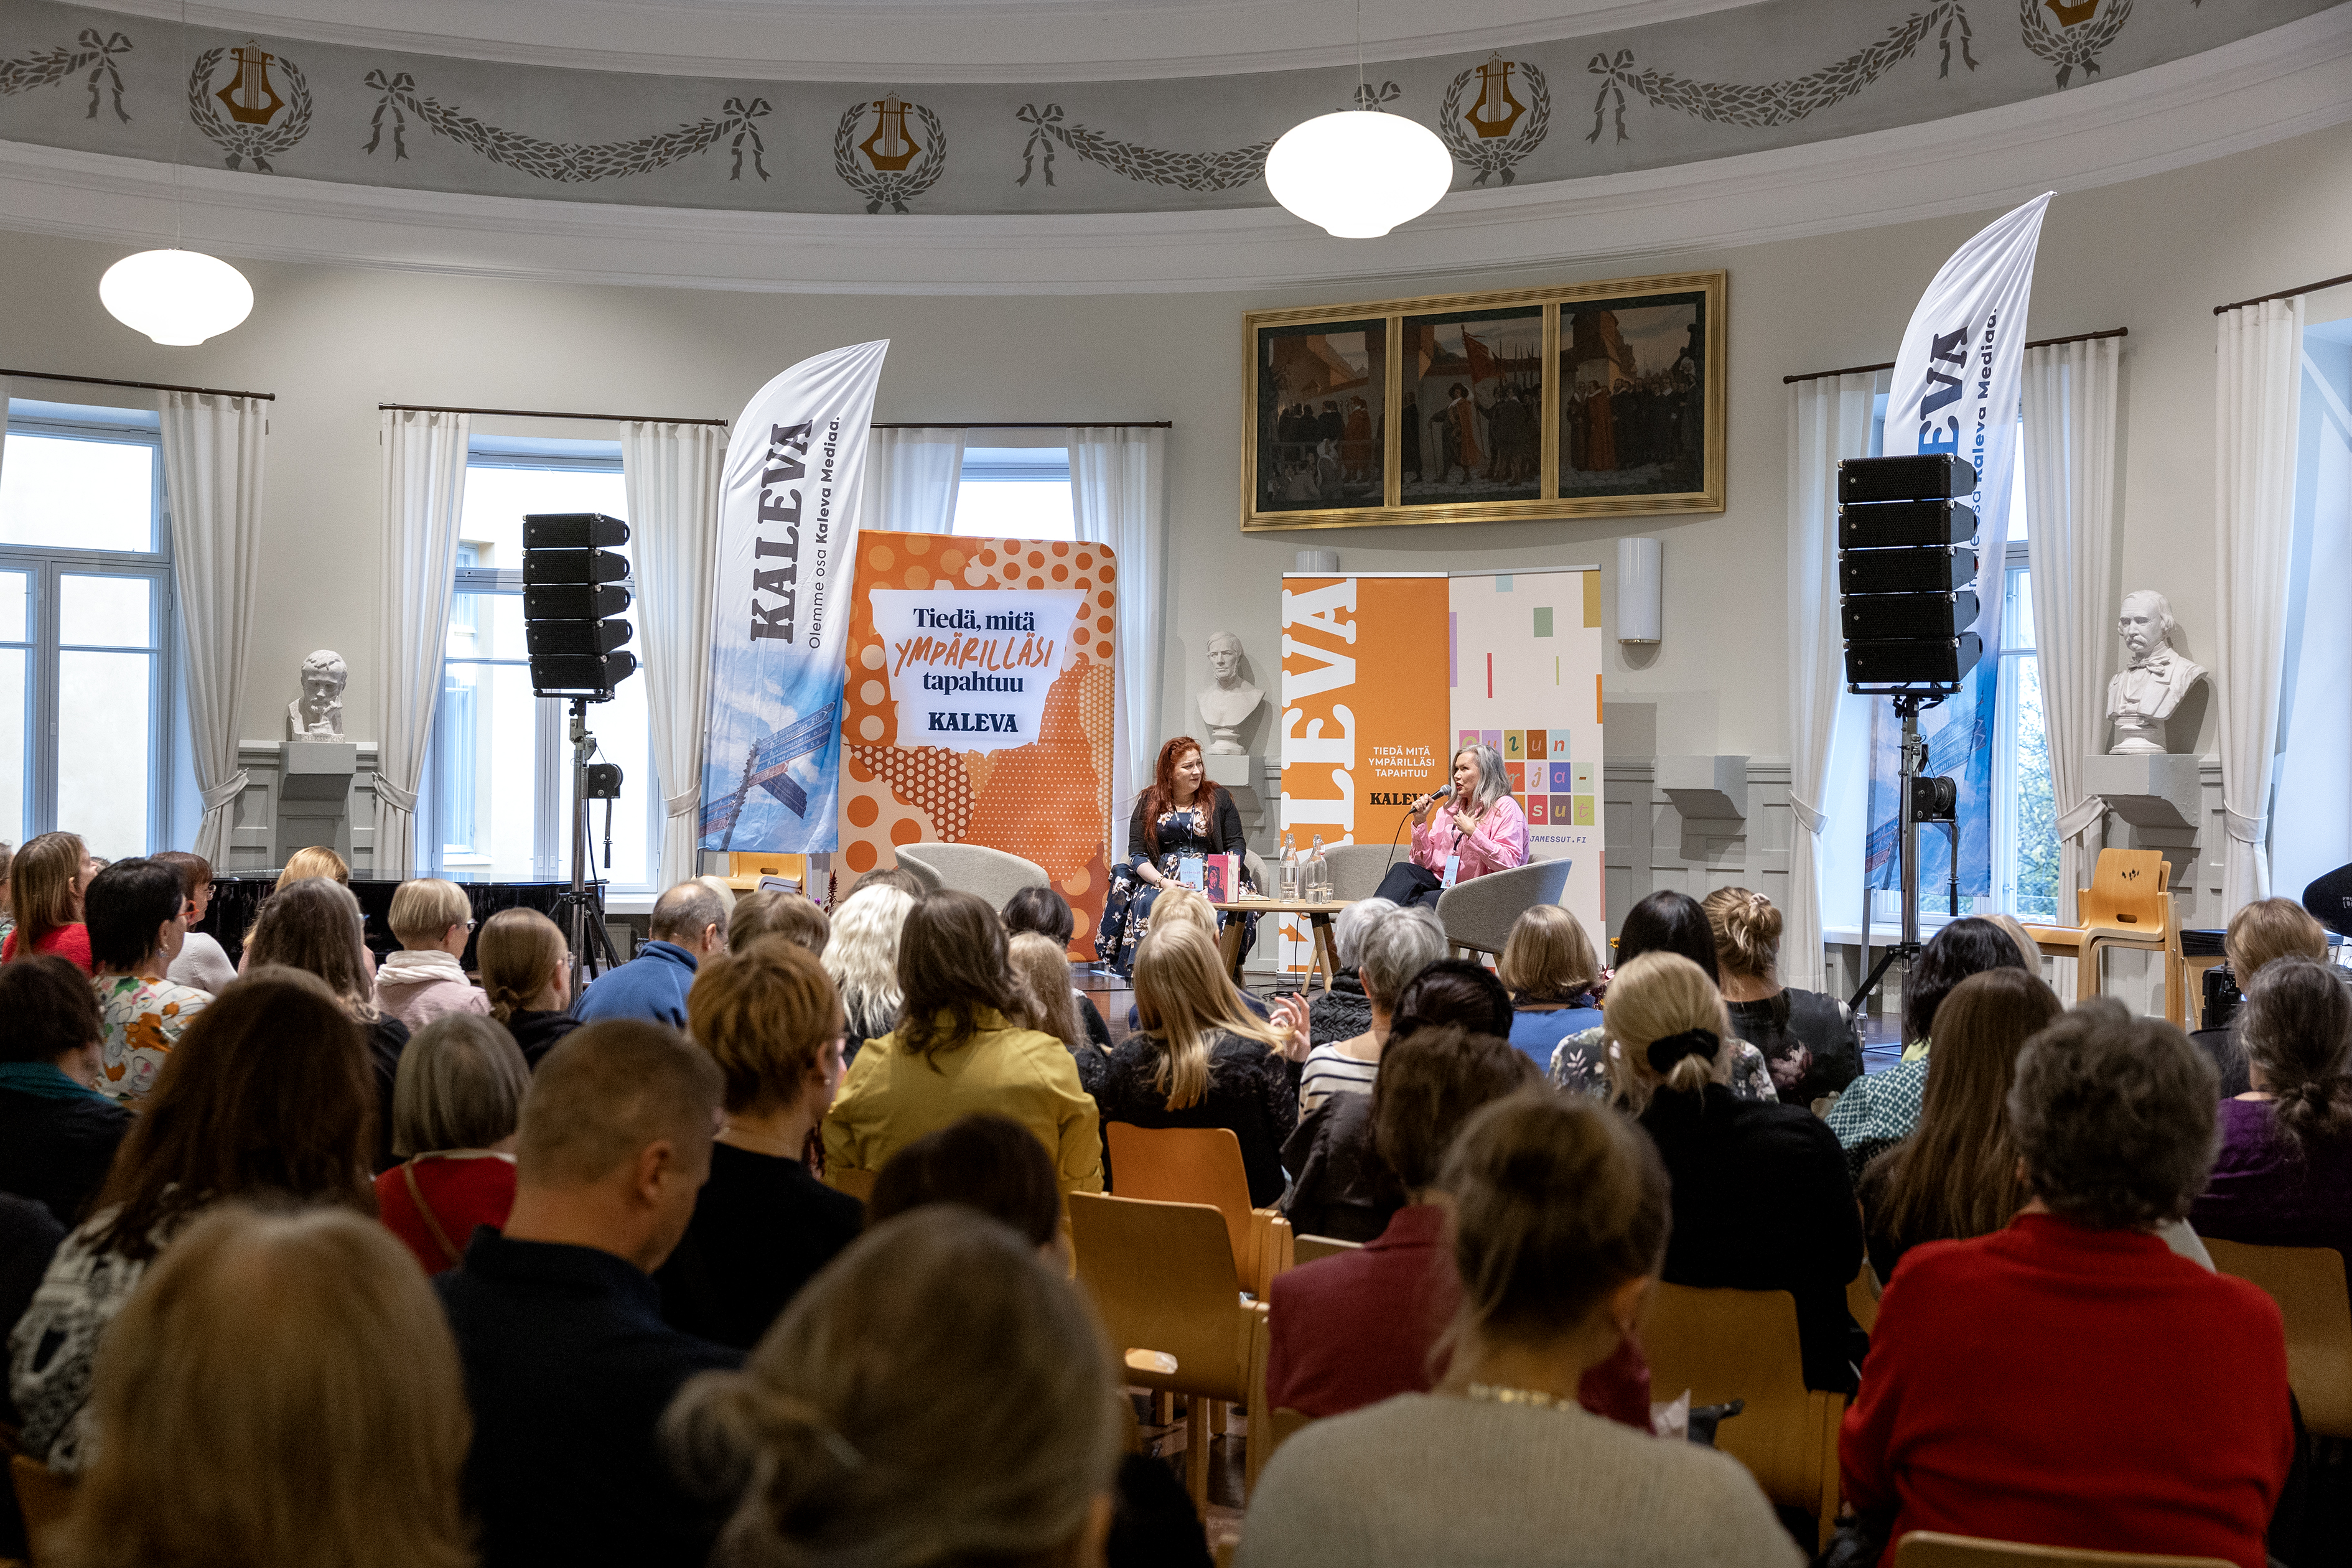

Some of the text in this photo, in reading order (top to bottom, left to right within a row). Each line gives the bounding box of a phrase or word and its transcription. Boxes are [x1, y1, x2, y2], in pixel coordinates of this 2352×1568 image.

[1977, 308, 1997, 399] Mediaa.
[1918, 325, 1968, 455] EVA
[750, 419, 813, 645] KALEVA
[809, 416, 840, 650] Olemme osa Kaleva Mediaa.
[913, 608, 1035, 632] Tiedä, mitä
[894, 632, 1053, 678] YMPÄRILLÄSI
[923, 671, 1024, 696] tapahtuu
[811, 715, 820, 724] 20
[928, 712, 1019, 732] KALEVA
[1373, 745, 1430, 755] TIEDÄ MITÄ
[1368, 756, 1435, 767] YMPÄRILLÄSI
[1279, 577, 1357, 972] LEVA
[1374, 768, 1428, 778] TAPAHTUU
[1507, 767, 1587, 788] rja-
[1370, 792, 1430, 805] KALEV
[1531, 803, 1589, 818] sut
[1529, 835, 1587, 844] JAMESSUT.FI
